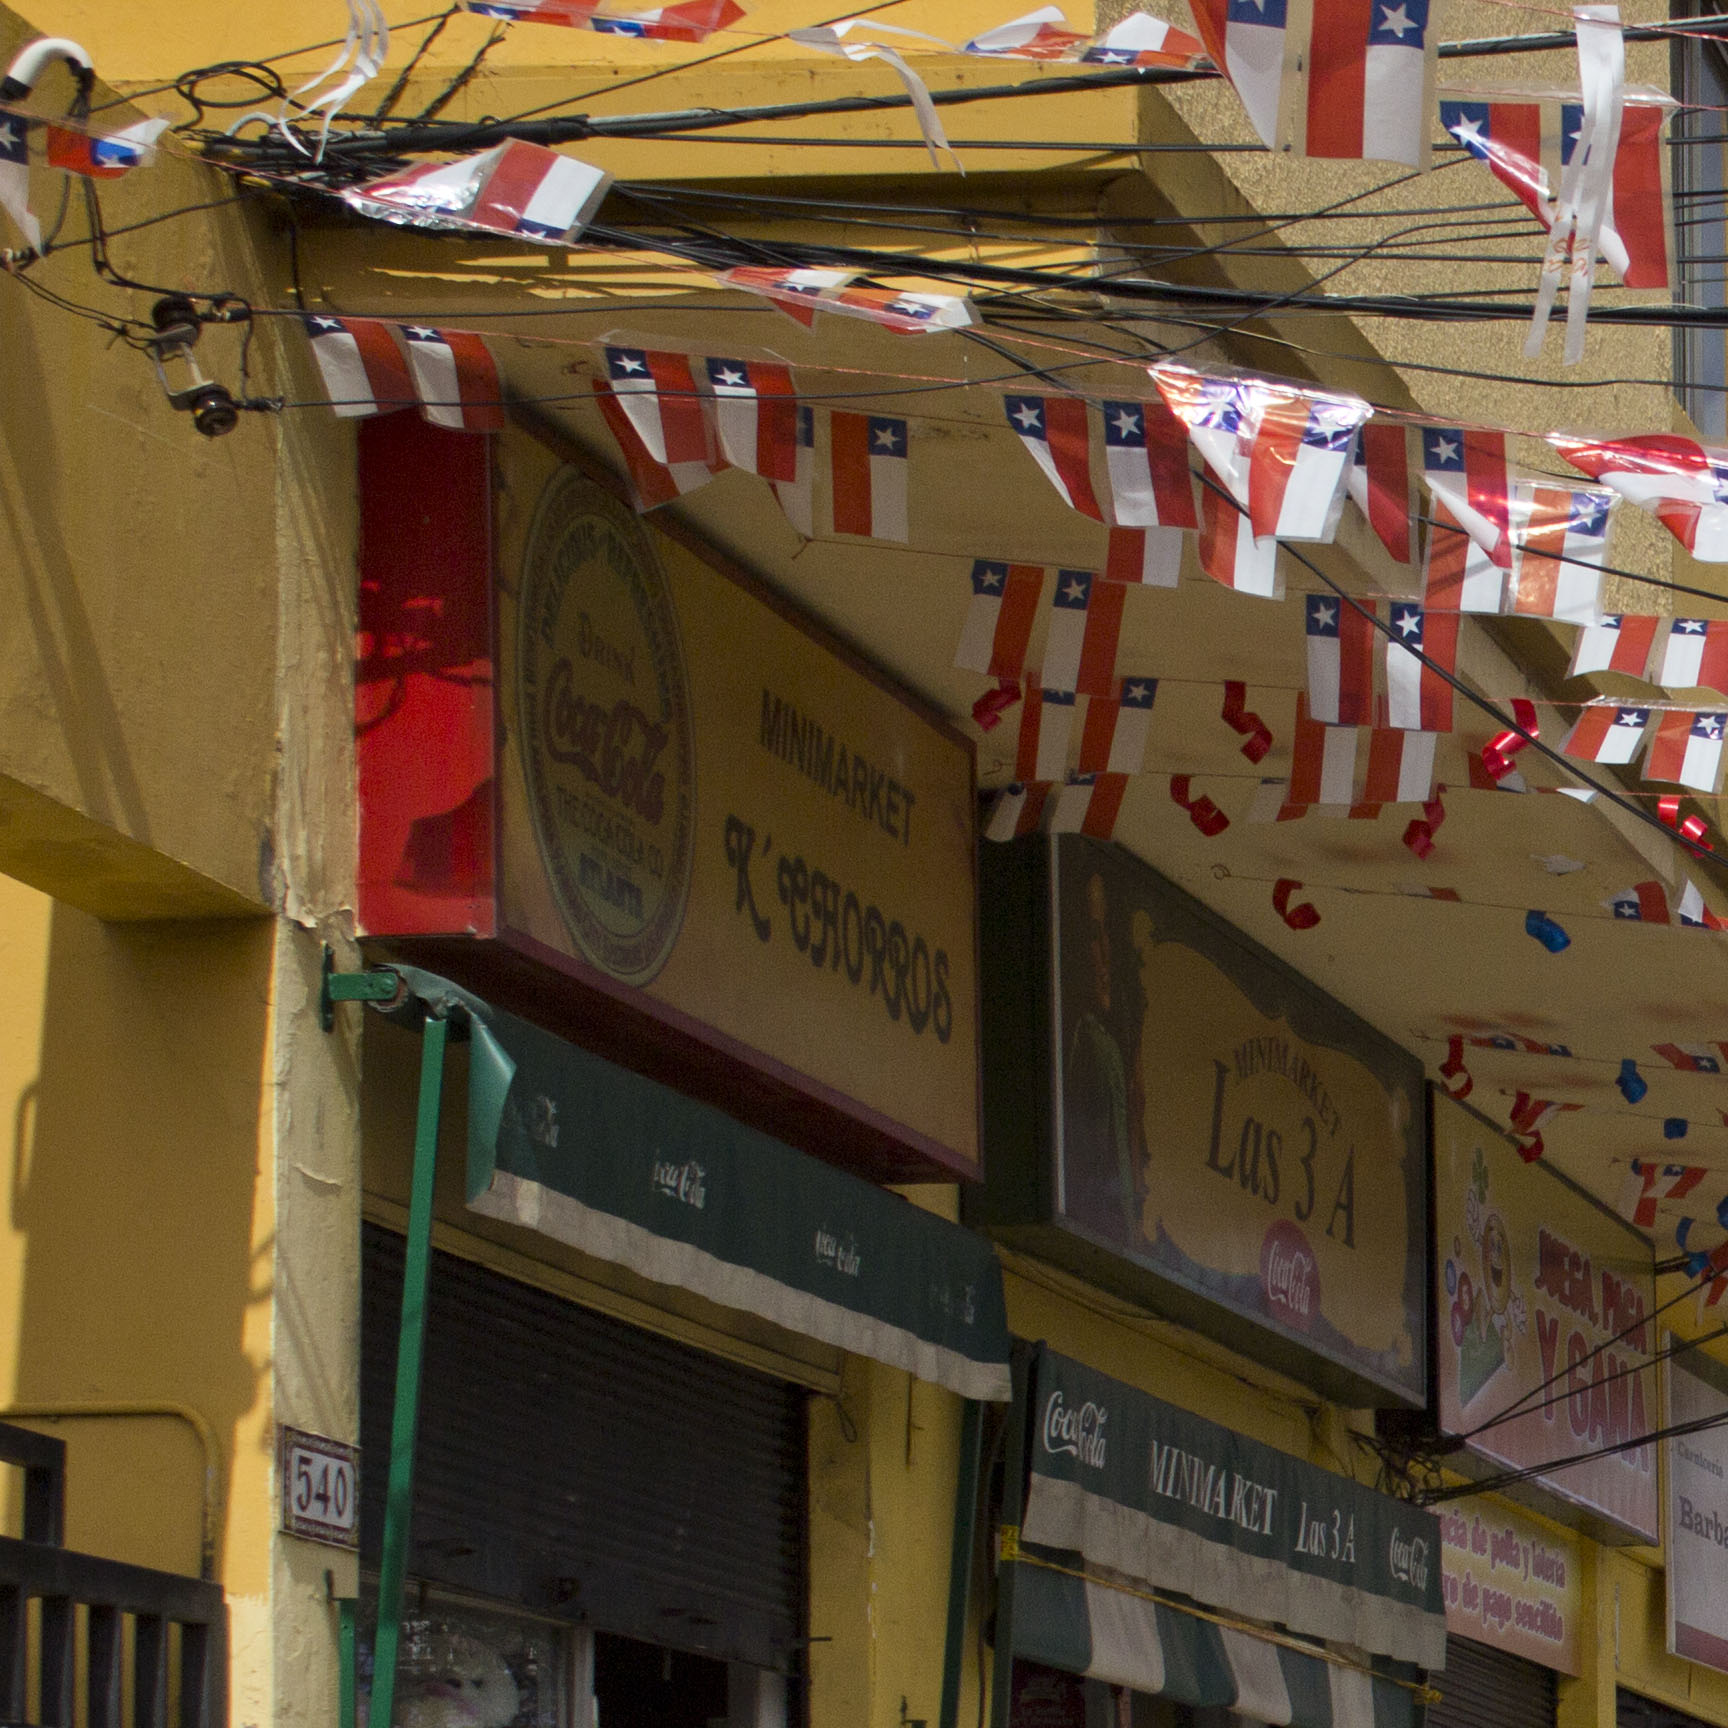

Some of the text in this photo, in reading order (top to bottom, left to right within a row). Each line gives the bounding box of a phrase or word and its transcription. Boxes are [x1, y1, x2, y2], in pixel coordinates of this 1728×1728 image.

[760, 687, 916, 847] MINIMARKET
[1205, 1058, 1356, 1251] Las 3 A
[1536, 1308, 1648, 1473] Y GANA
[296, 1455, 348, 1519] 540
[1151, 1439, 1278, 1536] MINIMARKET
[1295, 1501, 1327, 1557] Las
